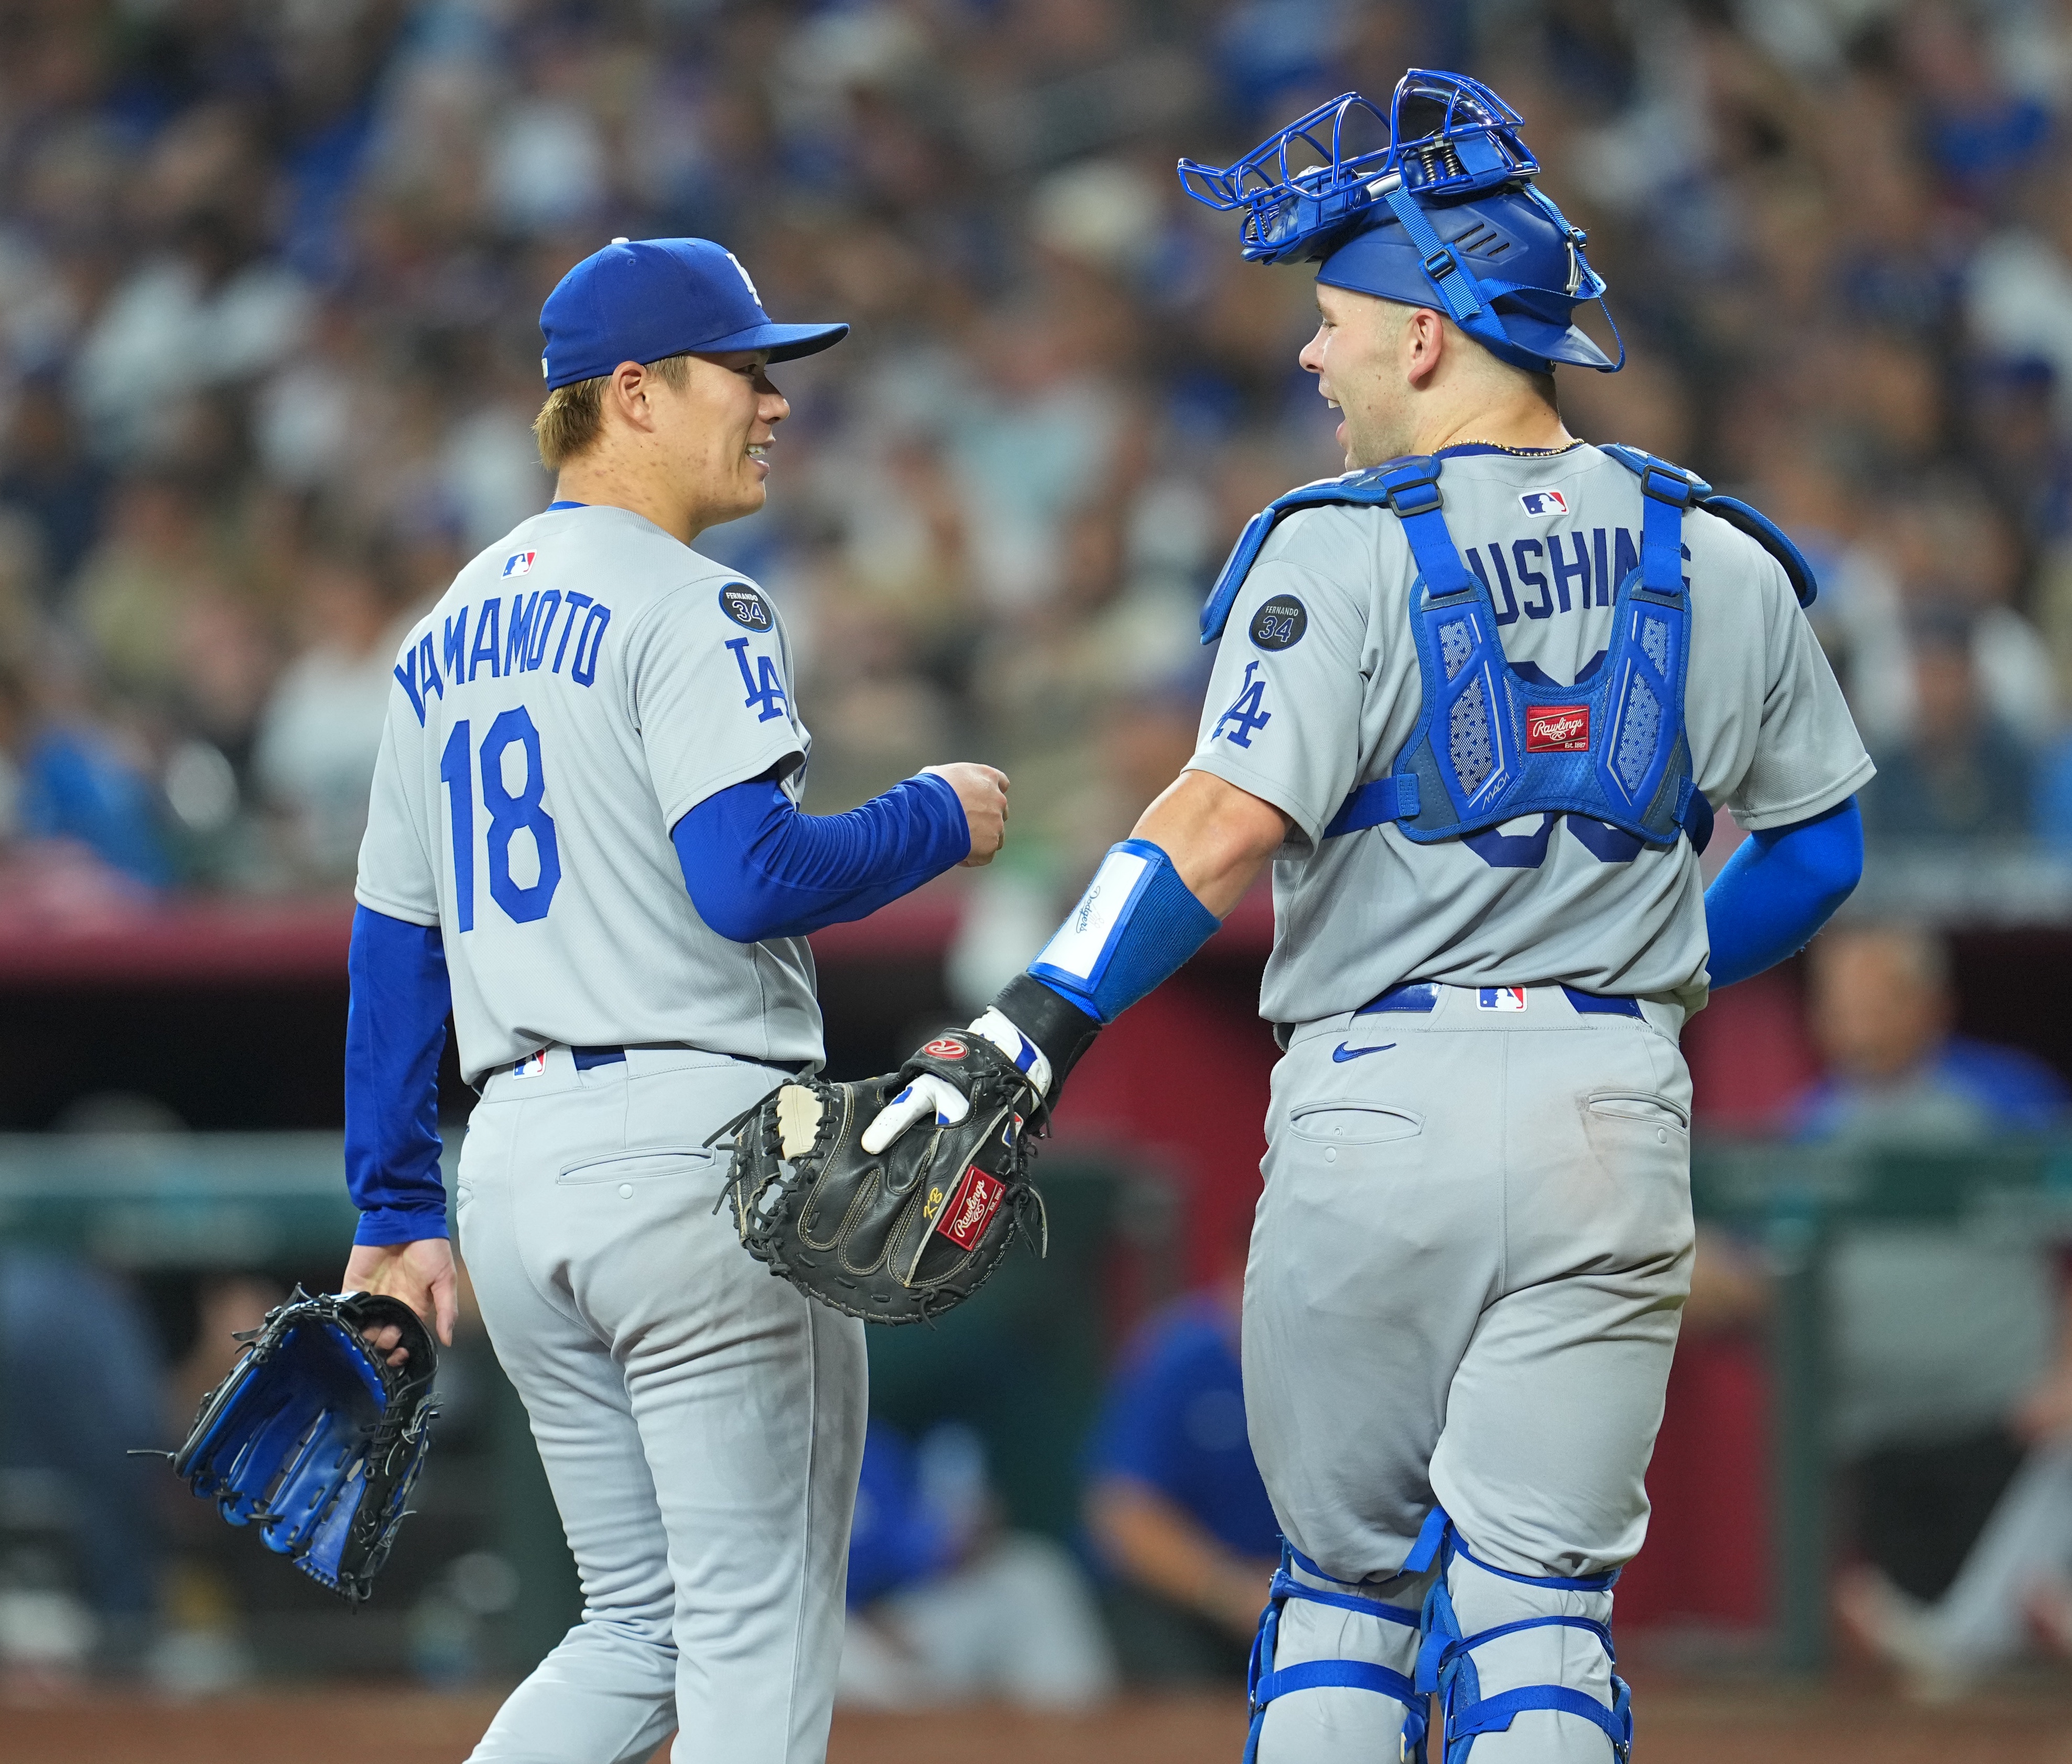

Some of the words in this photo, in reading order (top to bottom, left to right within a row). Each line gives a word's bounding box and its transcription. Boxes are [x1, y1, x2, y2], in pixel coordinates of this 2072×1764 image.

[1466, 527, 1691, 626] USHIN
[726, 592, 758, 602] FERNANDO
[732, 601, 767, 624] 34
[1265, 606, 1299, 616] FERNANDO
[1258, 615, 1294, 643] 34
[394, 590, 611, 728] YAMAMOTO
[724, 637, 791, 726] LA
[1533, 717, 1583, 737] Rawlings
[440, 704, 561, 934] 18
[1076, 885, 1101, 934] Dodgers
[954, 1180, 988, 1238] Rawlings
[989, 1200, 997, 1212] Est.
